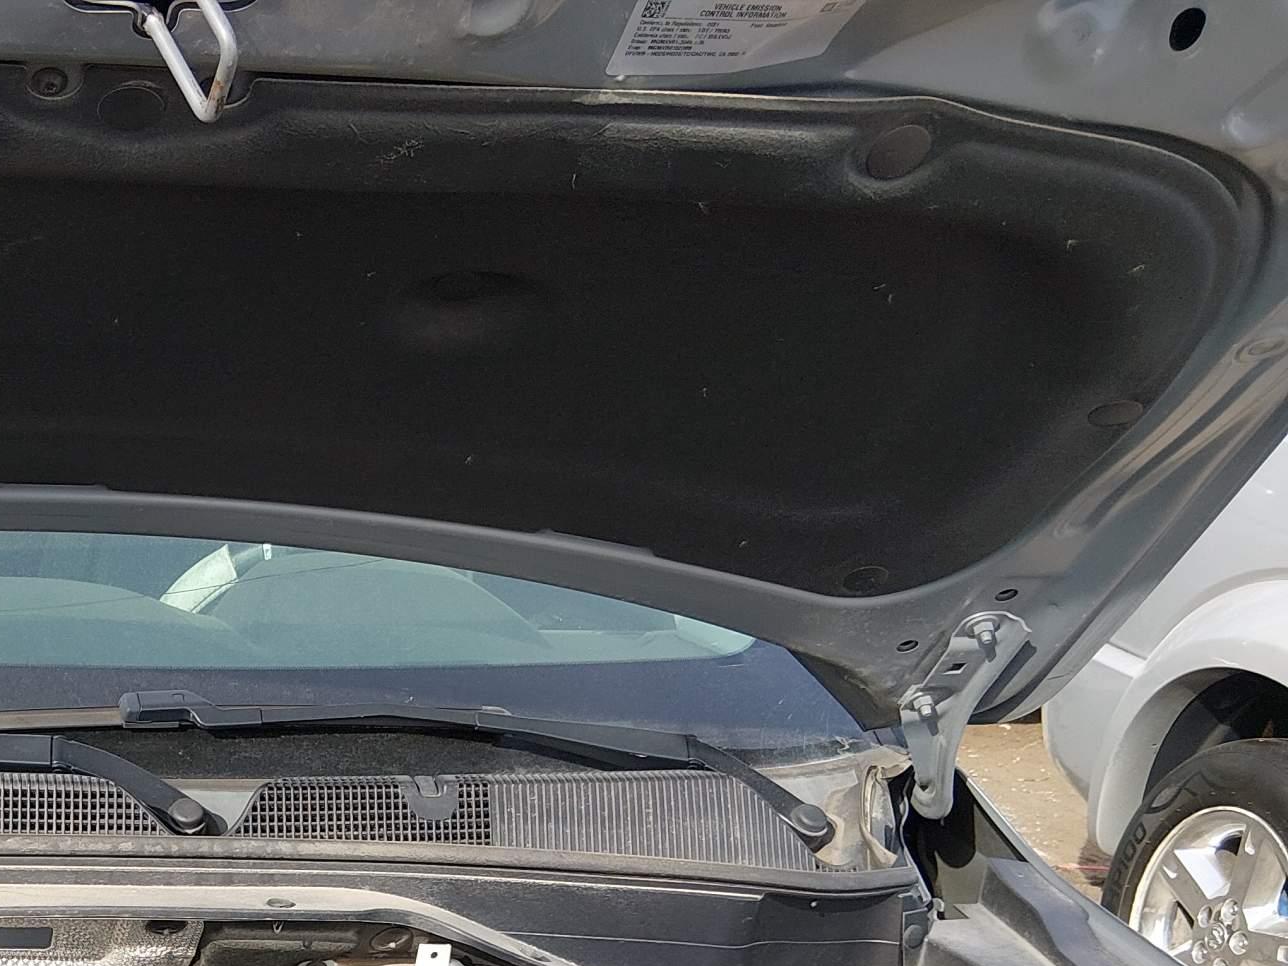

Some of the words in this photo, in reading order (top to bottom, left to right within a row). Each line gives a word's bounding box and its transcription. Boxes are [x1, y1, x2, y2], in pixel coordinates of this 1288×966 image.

[714, 3, 744, 11] VEHICLE
[746, 4, 782, 12] EMISSION
[736, 10, 787, 18] INFORMATION
